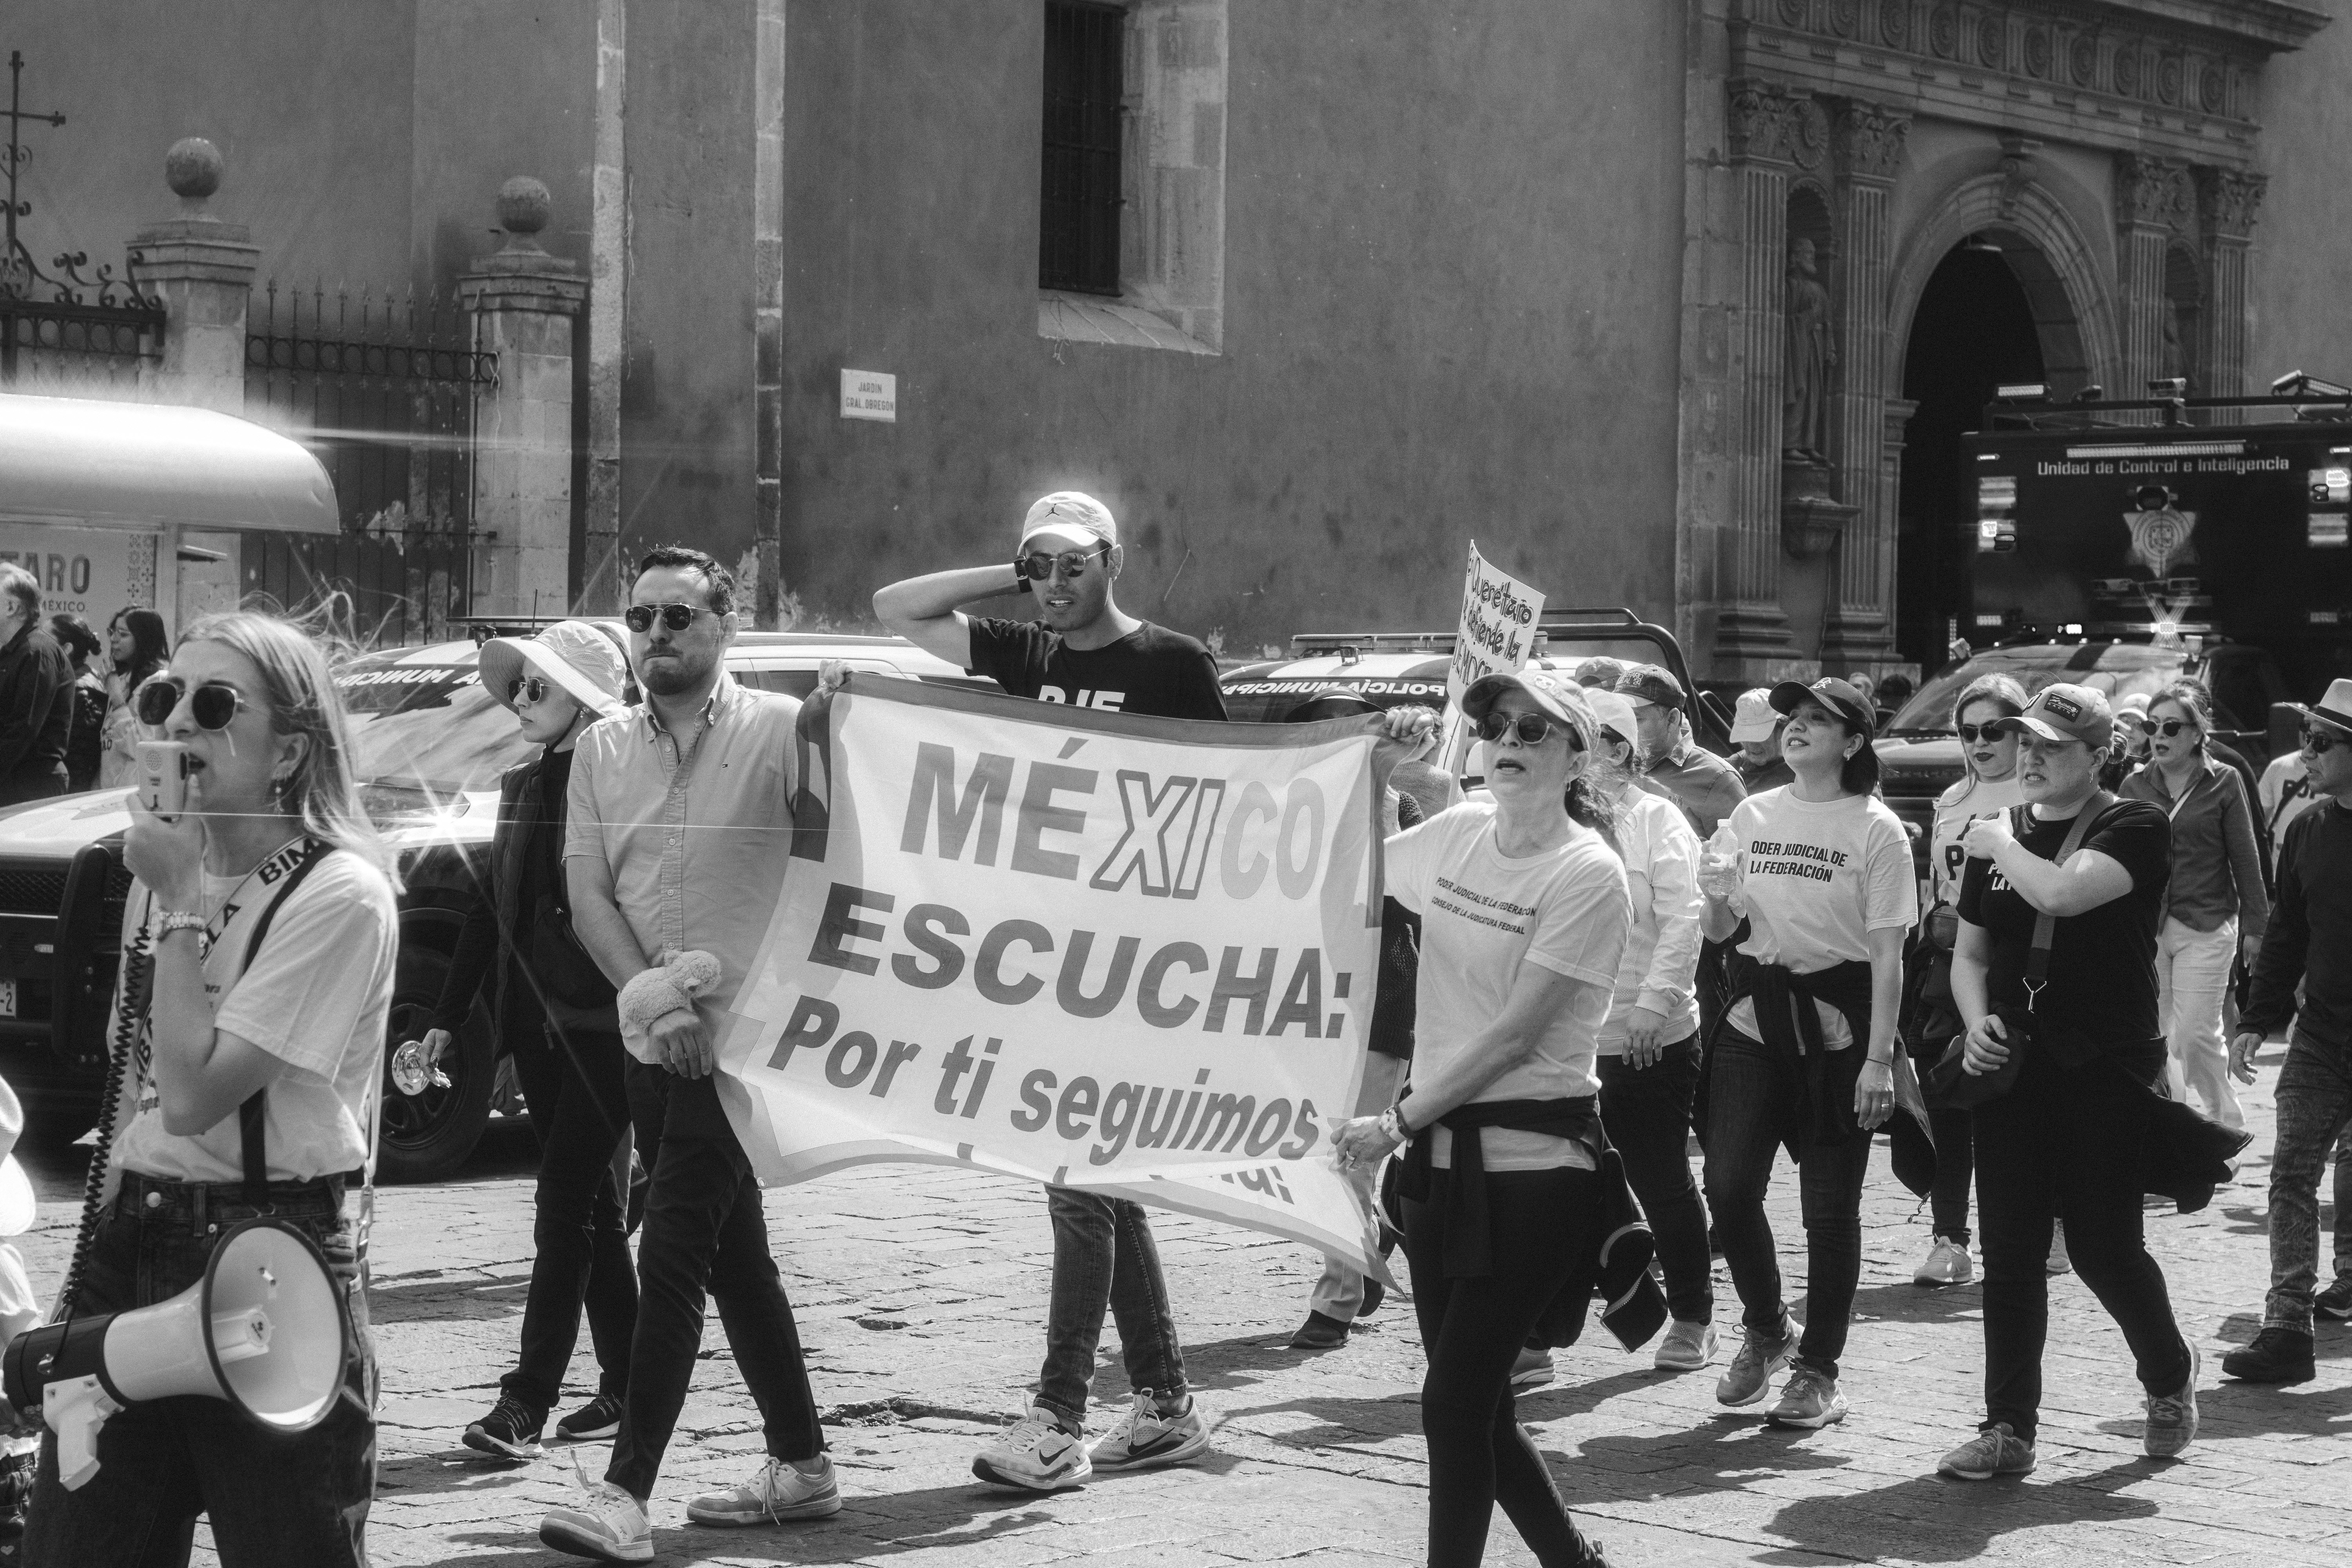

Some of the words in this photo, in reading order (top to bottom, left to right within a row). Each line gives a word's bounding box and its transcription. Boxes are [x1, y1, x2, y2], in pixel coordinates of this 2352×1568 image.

[2038, 461, 2090, 475] Unidad
[2095, 461, 2114, 474] de
[2120, 458, 2177, 474] Control
[2183, 461, 2192, 472] e
[2198, 456, 2289, 475] Inteligencia
[1504, 628, 1523, 666] la
[2047, 702, 2076, 717] RACING
[900, 737, 1326, 900] MÉXICO
[1751, 840, 1782, 856] ODER
[1782, 843, 1829, 862] JUDICIAL
[1830, 850, 1848, 867] DE
[1750, 860, 1762, 874] LA
[1762, 860, 1833, 883] FEDERACIÓN
[1436, 877, 1454, 890] PODER
[1453, 886, 1481, 904] JUDICIAL
[1488, 898, 1498, 909] LA
[1459, 909, 1468, 918] LA
[1498, 922, 1525, 935] FEDERAL
[807, 882, 1352, 1039] ESCUCHA:
[767, 994, 922, 1097] Por
[934, 1034, 1002, 1119] ti
[1010, 1068, 1318, 1166] seguimos
